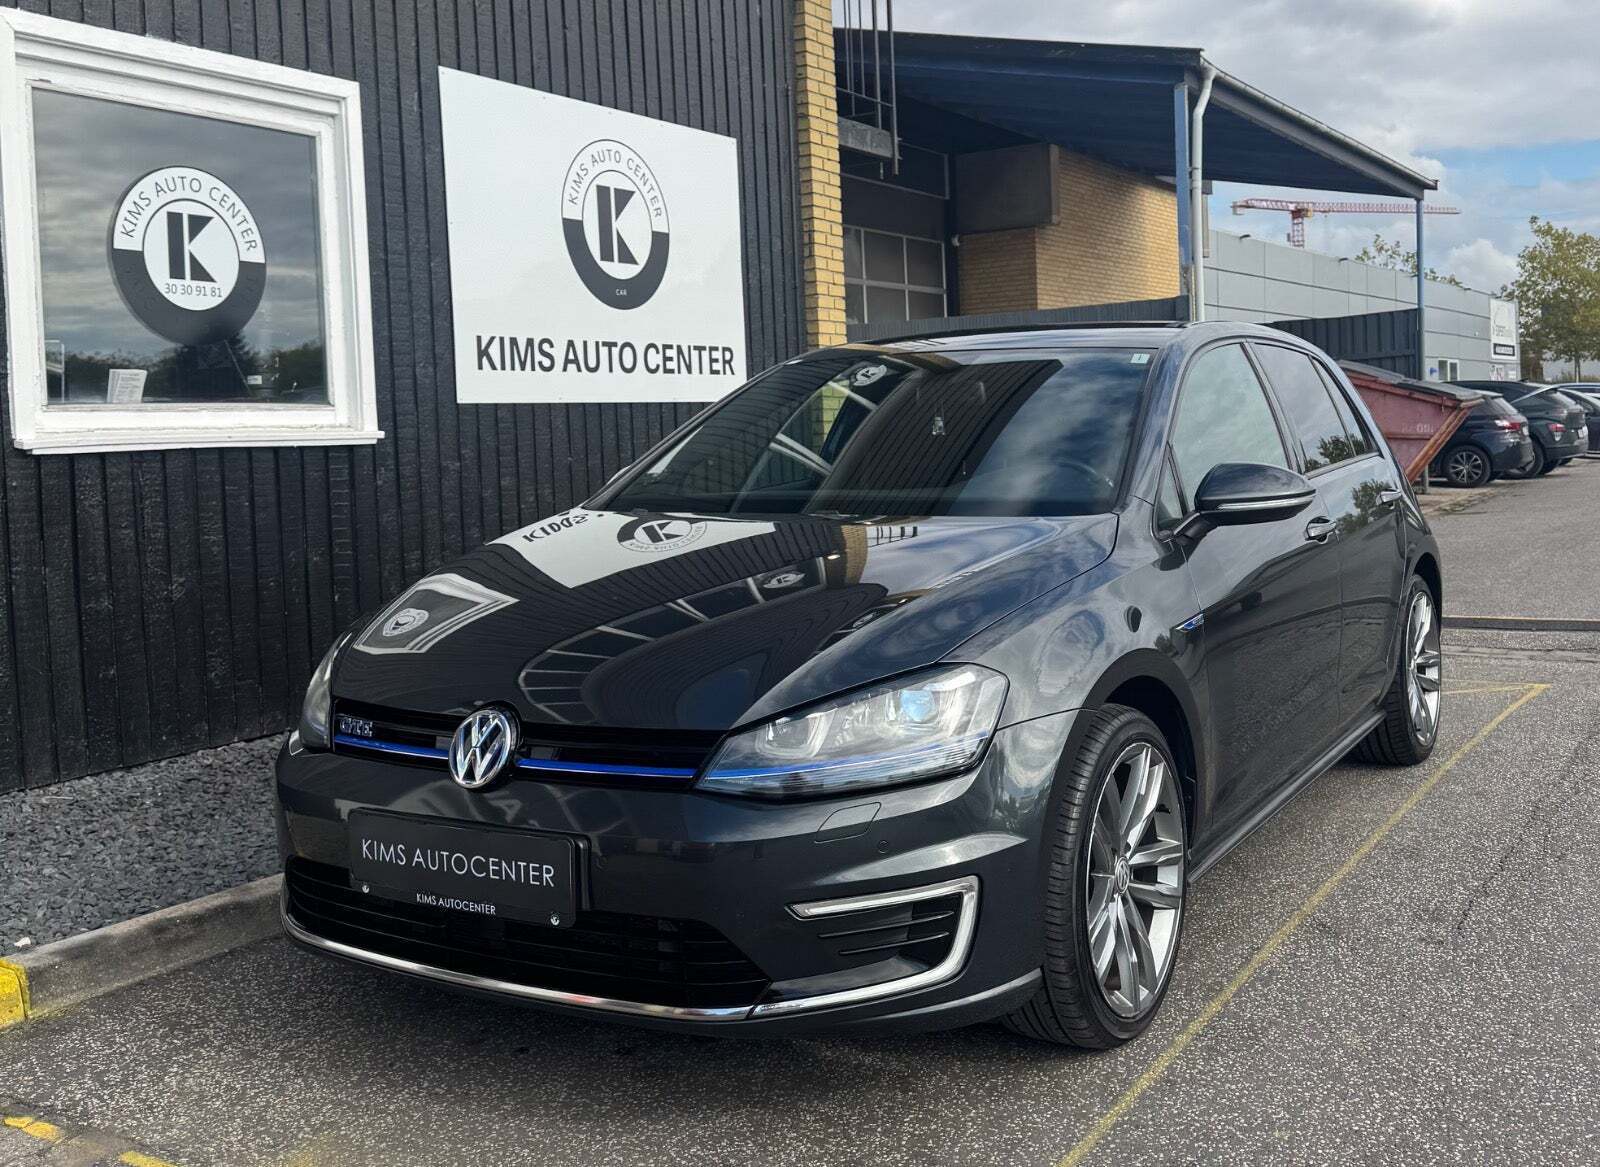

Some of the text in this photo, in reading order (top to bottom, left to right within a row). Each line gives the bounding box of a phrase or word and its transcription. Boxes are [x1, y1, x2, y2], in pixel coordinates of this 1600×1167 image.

[568, 149, 662, 217] KIMS AUTO CENTER
[120, 176, 257, 251] KIMS AUTO CENTER
[596, 184, 640, 266] K
[166, 211, 217, 283] K
[165, 283, 223, 298] 30 30 91 81
[476, 335, 735, 376] KIMS AUTO CENTER
[362, 838, 555, 888] KIMS AUTOCENTER
[416, 893, 496, 916] KIMS AUTOCENTER
